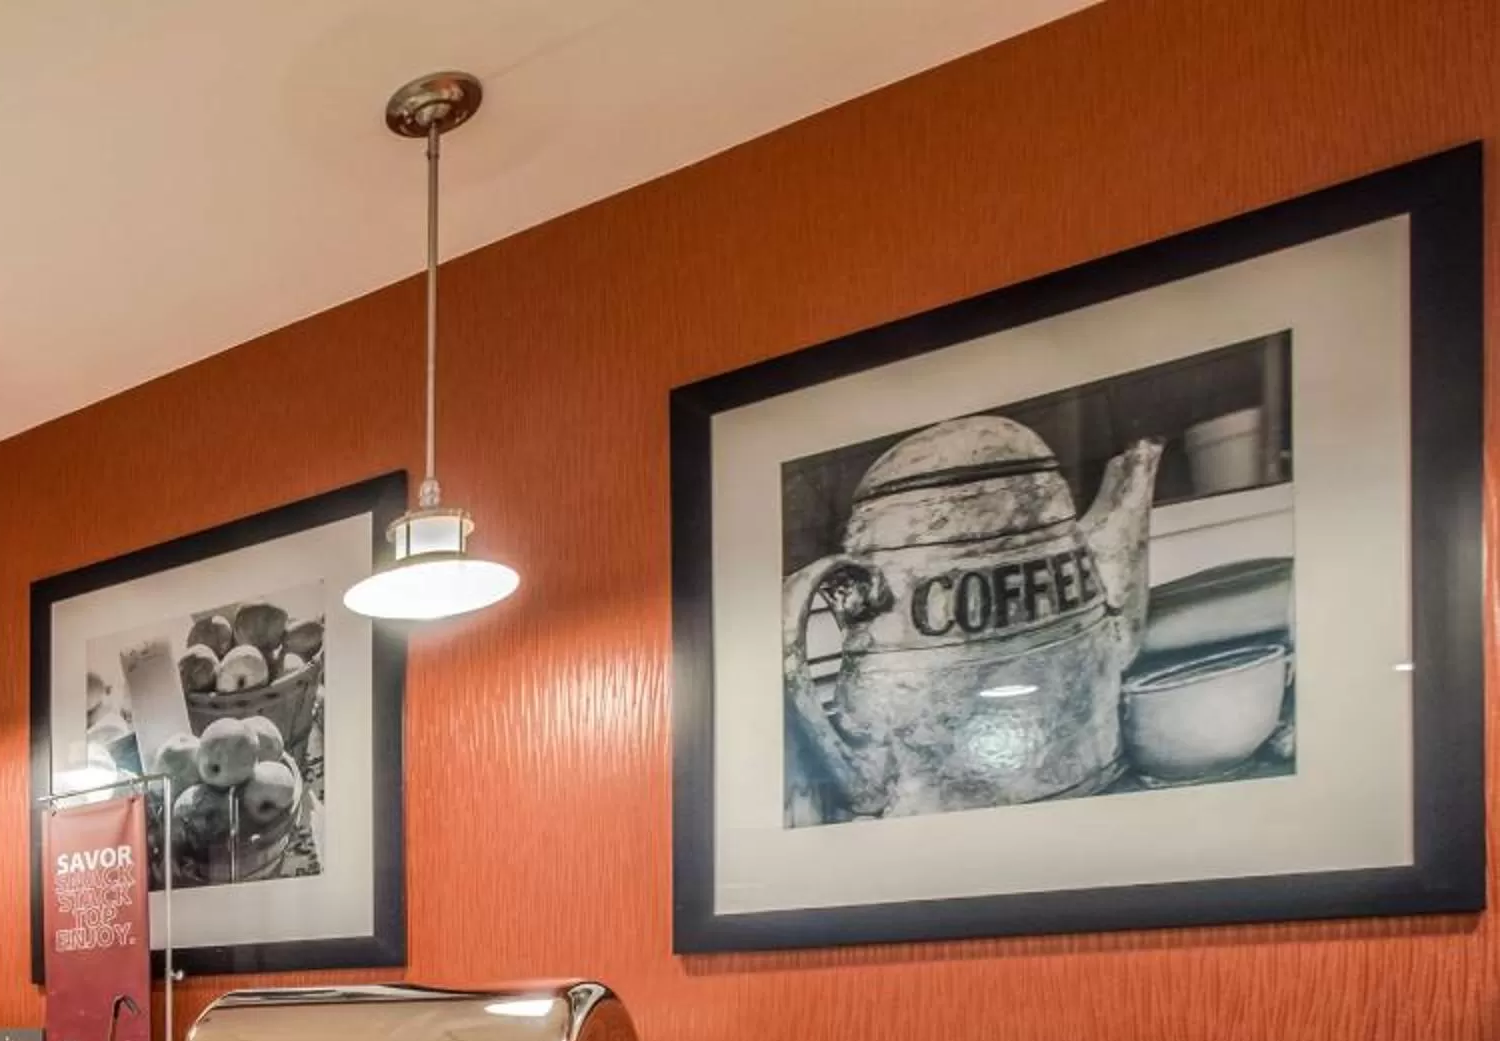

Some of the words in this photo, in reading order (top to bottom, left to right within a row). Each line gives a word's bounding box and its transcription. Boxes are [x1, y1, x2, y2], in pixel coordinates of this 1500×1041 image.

[911, 546, 1097, 636] COFFEE
[57, 845, 134, 875] SAVOR
[58, 884, 133, 913] STACK
[72, 906, 117, 930] TOP
[55, 921, 137, 953] ENJOY.
